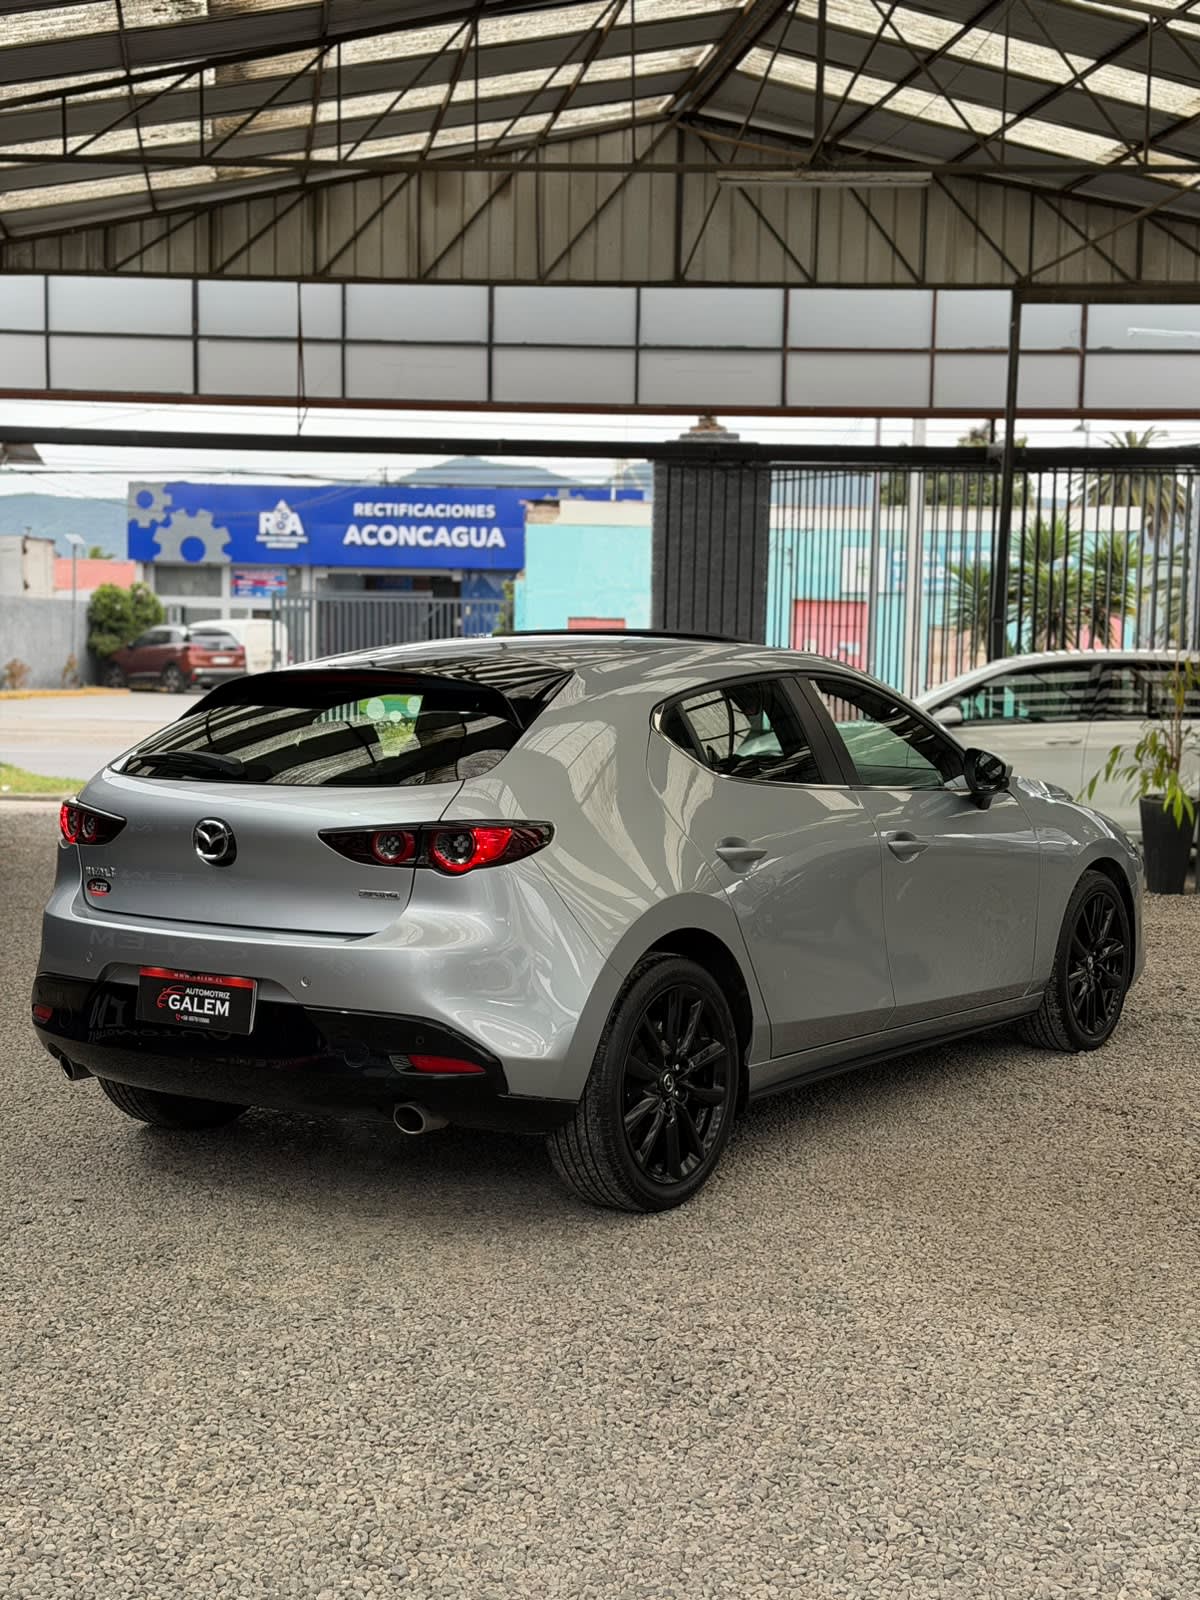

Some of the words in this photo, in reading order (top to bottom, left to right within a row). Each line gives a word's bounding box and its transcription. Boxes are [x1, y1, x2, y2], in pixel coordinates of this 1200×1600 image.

[353, 502, 496, 519] RECTIFICACIONES
[342, 524, 506, 548] ACONCAGUA
[185, 987, 231, 1000] AUTOMOTRIZ
[168, 994, 230, 1017] GALEM
